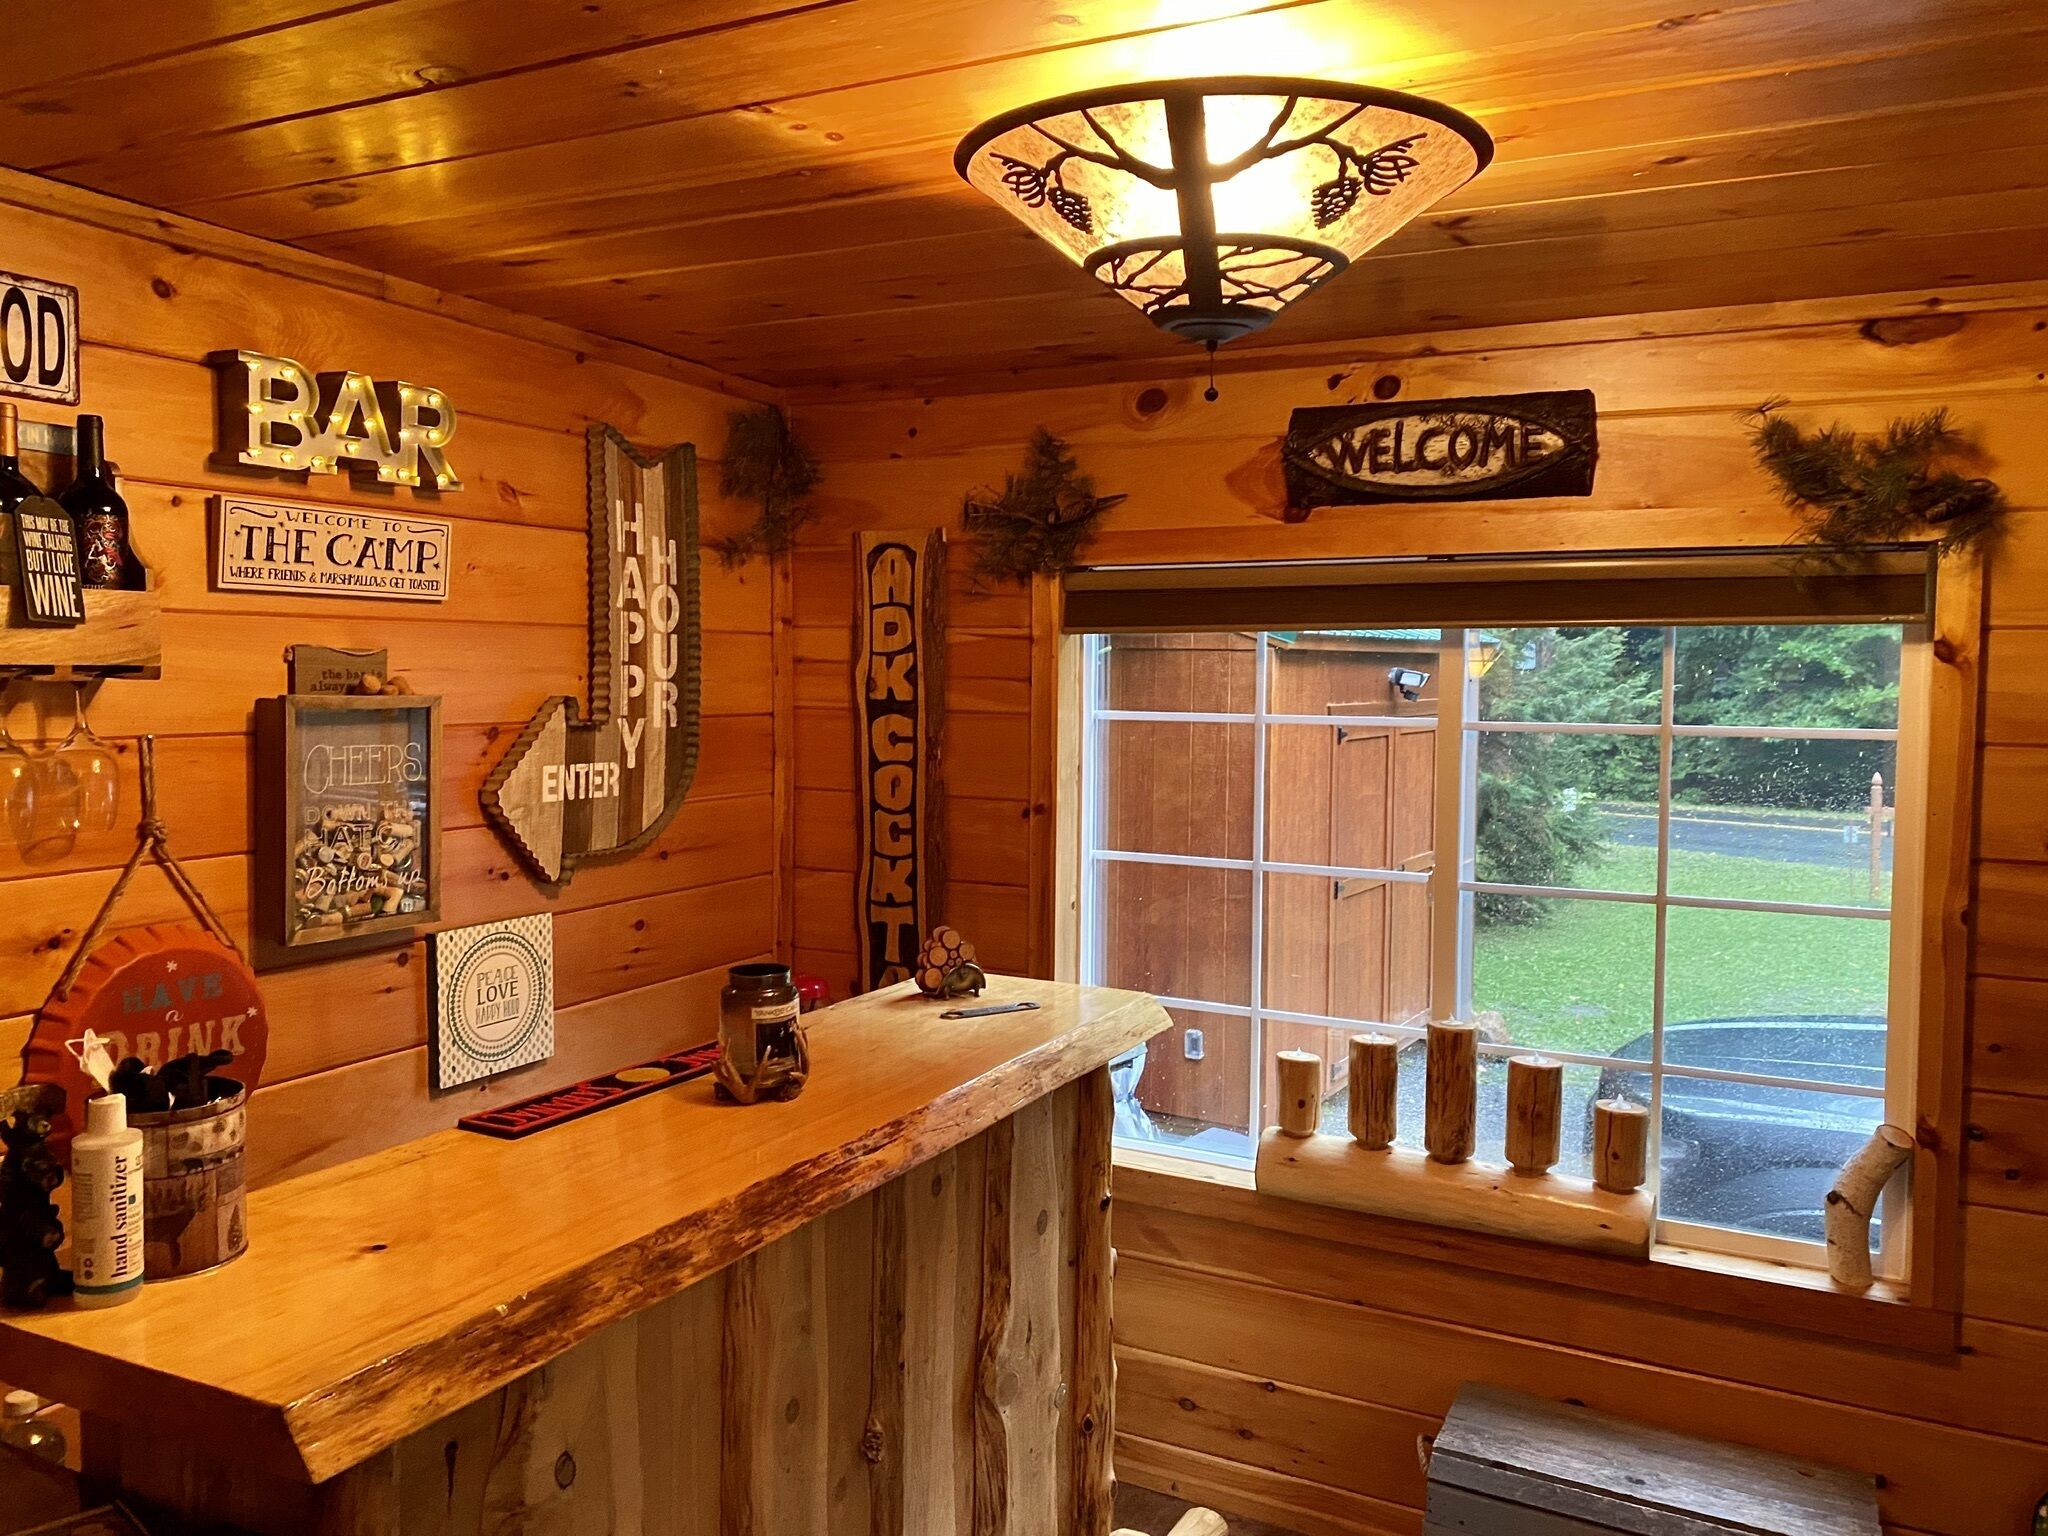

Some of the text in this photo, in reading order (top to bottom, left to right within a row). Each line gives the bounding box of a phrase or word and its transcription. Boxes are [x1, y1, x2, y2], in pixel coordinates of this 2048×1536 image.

[236, 350, 464, 492] BAR
[1328, 421, 1546, 474] WELCOME
[20, 513, 36, 530] THIS
[58, 518, 71, 534] THE
[22, 530, 73, 552] WINE TALKING
[286, 510, 401, 532] WELCOME TO
[25, 548, 75, 575] BUT I LOVE
[240, 524, 438, 574] THE CAMP
[28, 572, 81, 617] WINE
[229, 566, 441, 591] WHERE FRIENDS & MARSHMALLOWS GET TOASTED
[615, 499, 647, 769] HAPPY
[651, 535, 680, 728] HOUR
[870, 546, 914, 700] ADK
[322, 669, 342, 680] the
[303, 742, 423, 794] CHEERS
[542, 762, 620, 803] ENTER
[305, 803, 374, 825] DOWN
[398, 870, 421, 893] up
[121, 972, 224, 1015] HAVE
[476, 964, 519, 988] PEACE
[476, 980, 519, 1006] LOVE
[165, 1009, 184, 1022] a
[97, 1014, 246, 1076] DRINK
[110, 1156, 128, 1278] hand sanitizer
